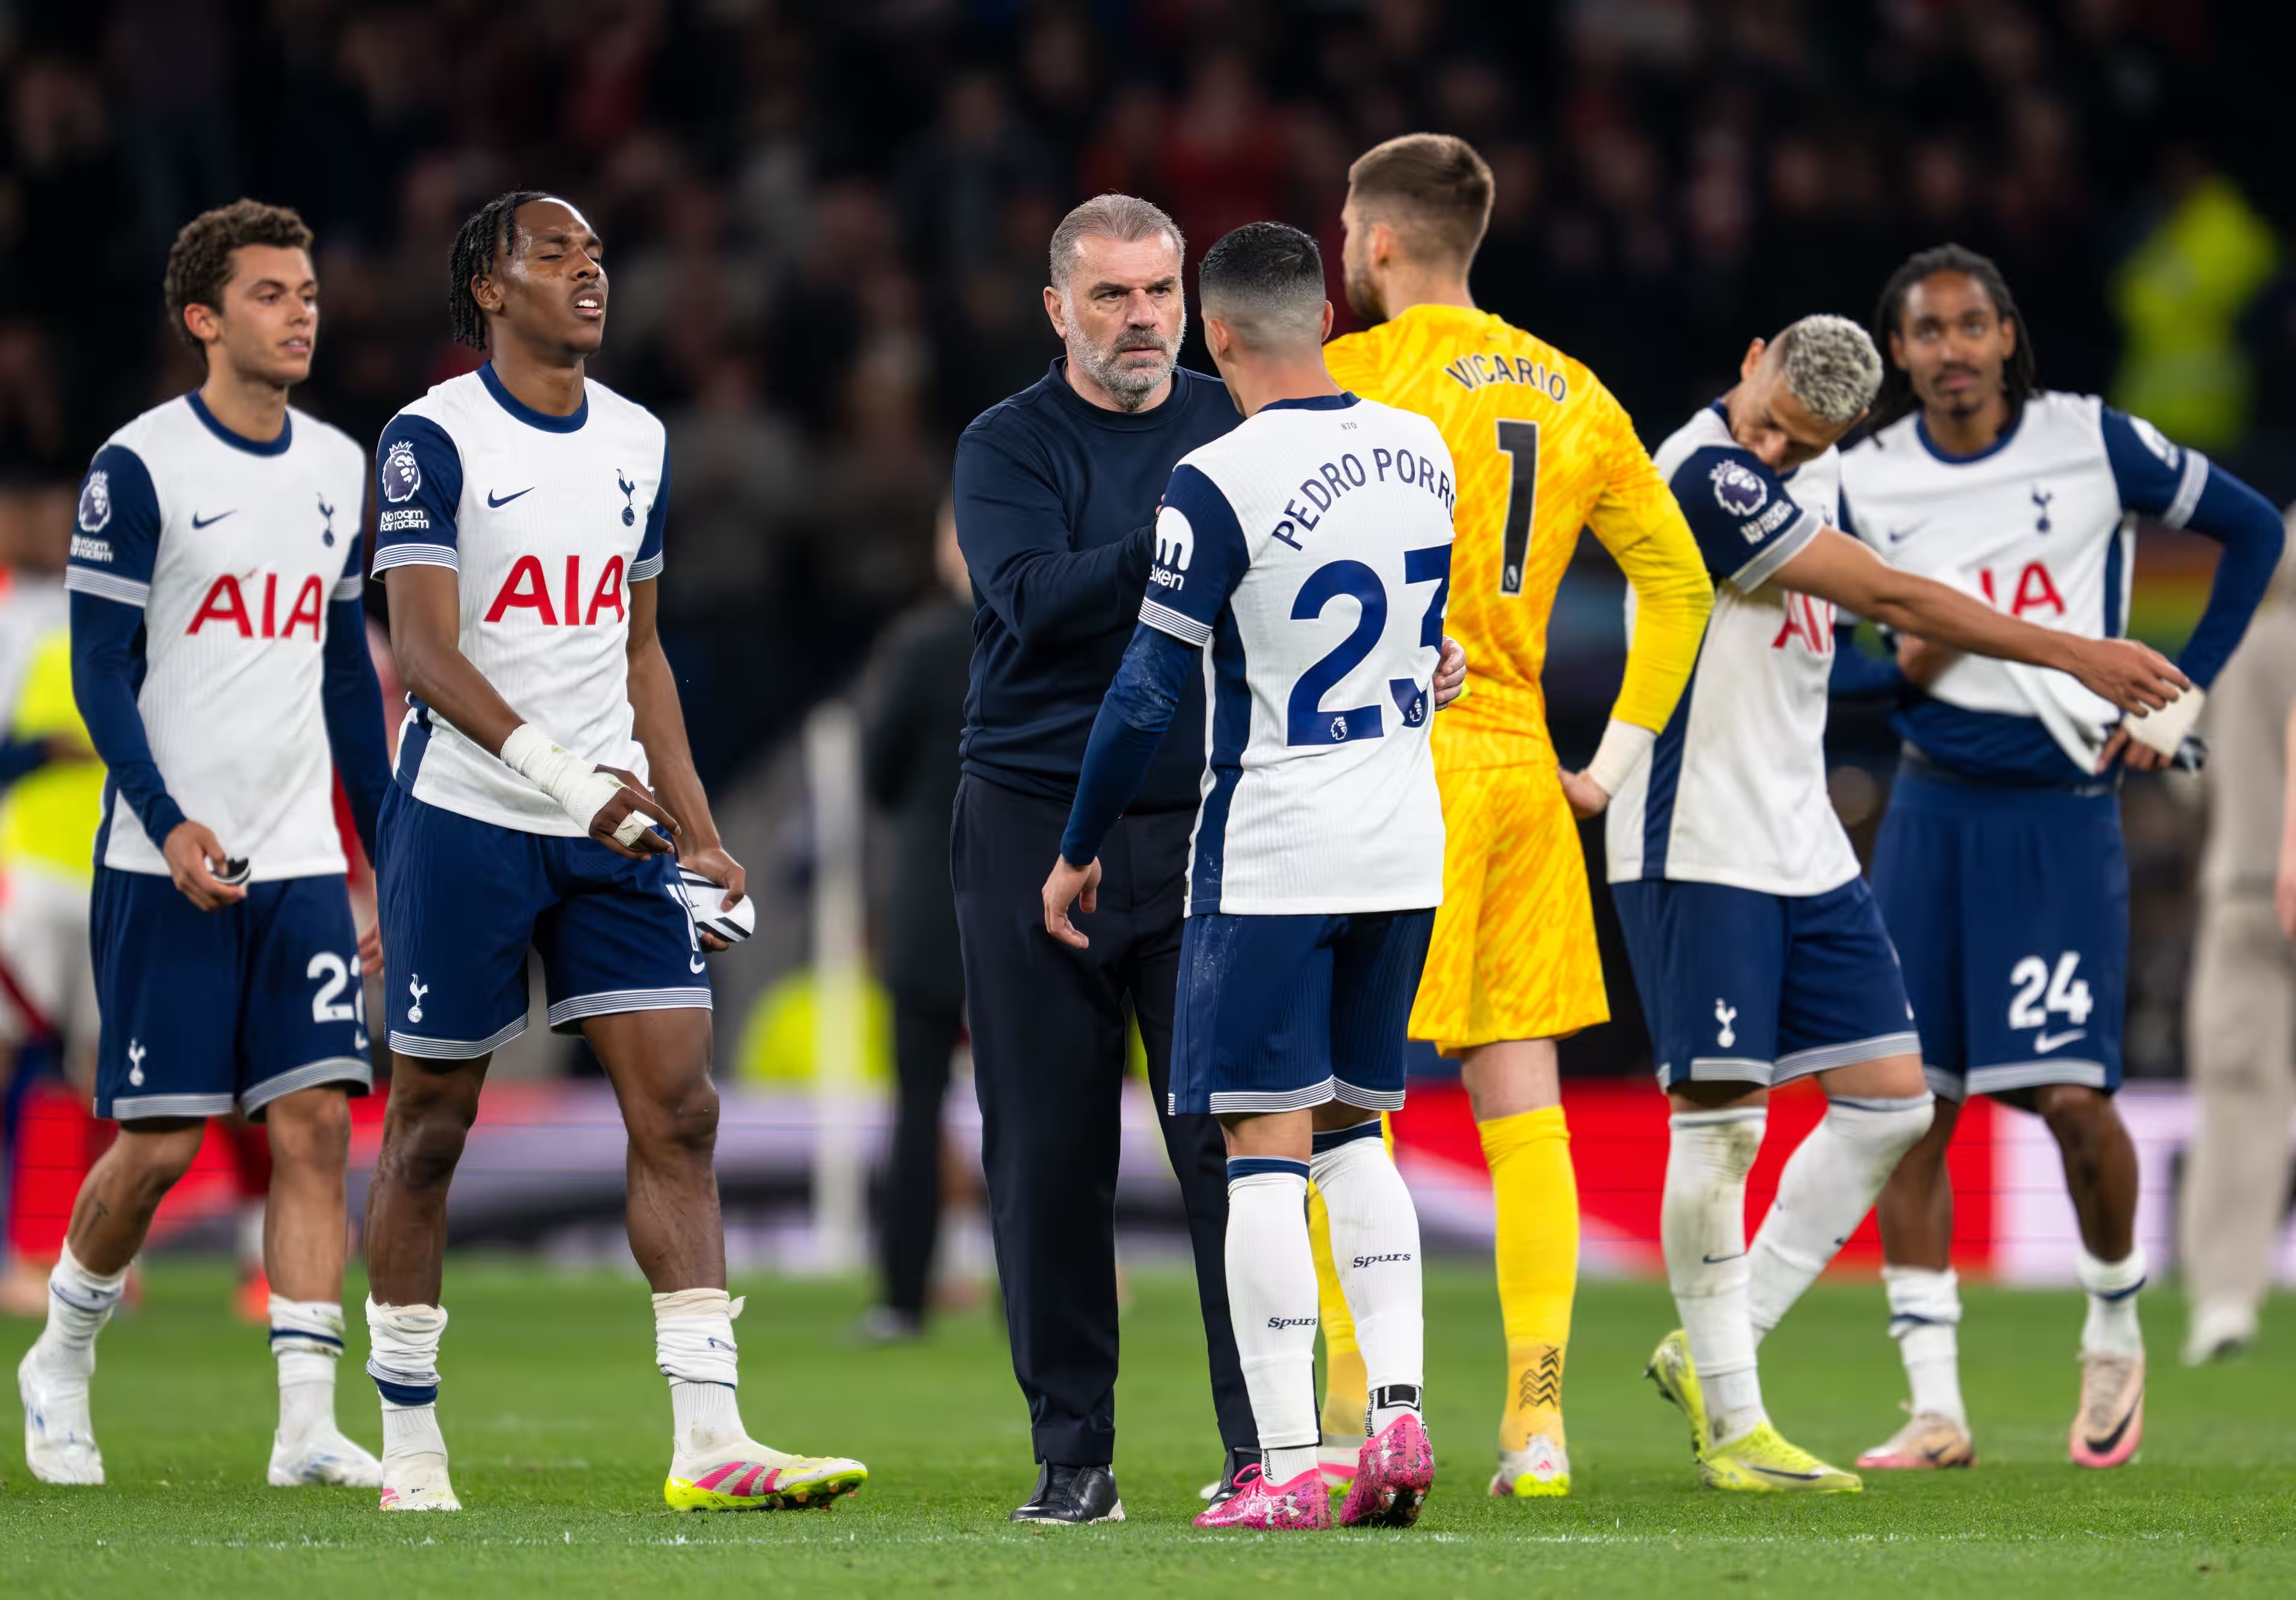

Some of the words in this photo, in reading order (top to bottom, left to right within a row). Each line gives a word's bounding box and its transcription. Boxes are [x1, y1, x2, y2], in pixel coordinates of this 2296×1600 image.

[1445, 355, 1566, 402] VICARIO
[381, 512, 393, 522] No
[394, 510, 423, 520] room
[394, 519, 429, 531] racism
[1271, 453, 1366, 552] PEDRO
[1495, 418, 1539, 596] 1
[484, 555, 625, 626] AIA
[1149, 564, 1184, 590] aken
[1979, 562, 2065, 619] IA
[186, 573, 323, 641] AIA
[1287, 543, 1453, 747] 23
[2009, 950, 2093, 1029] 24
[1353, 1254, 1411, 1269] Spurs
[1268, 1317, 1317, 1330] Spurs
